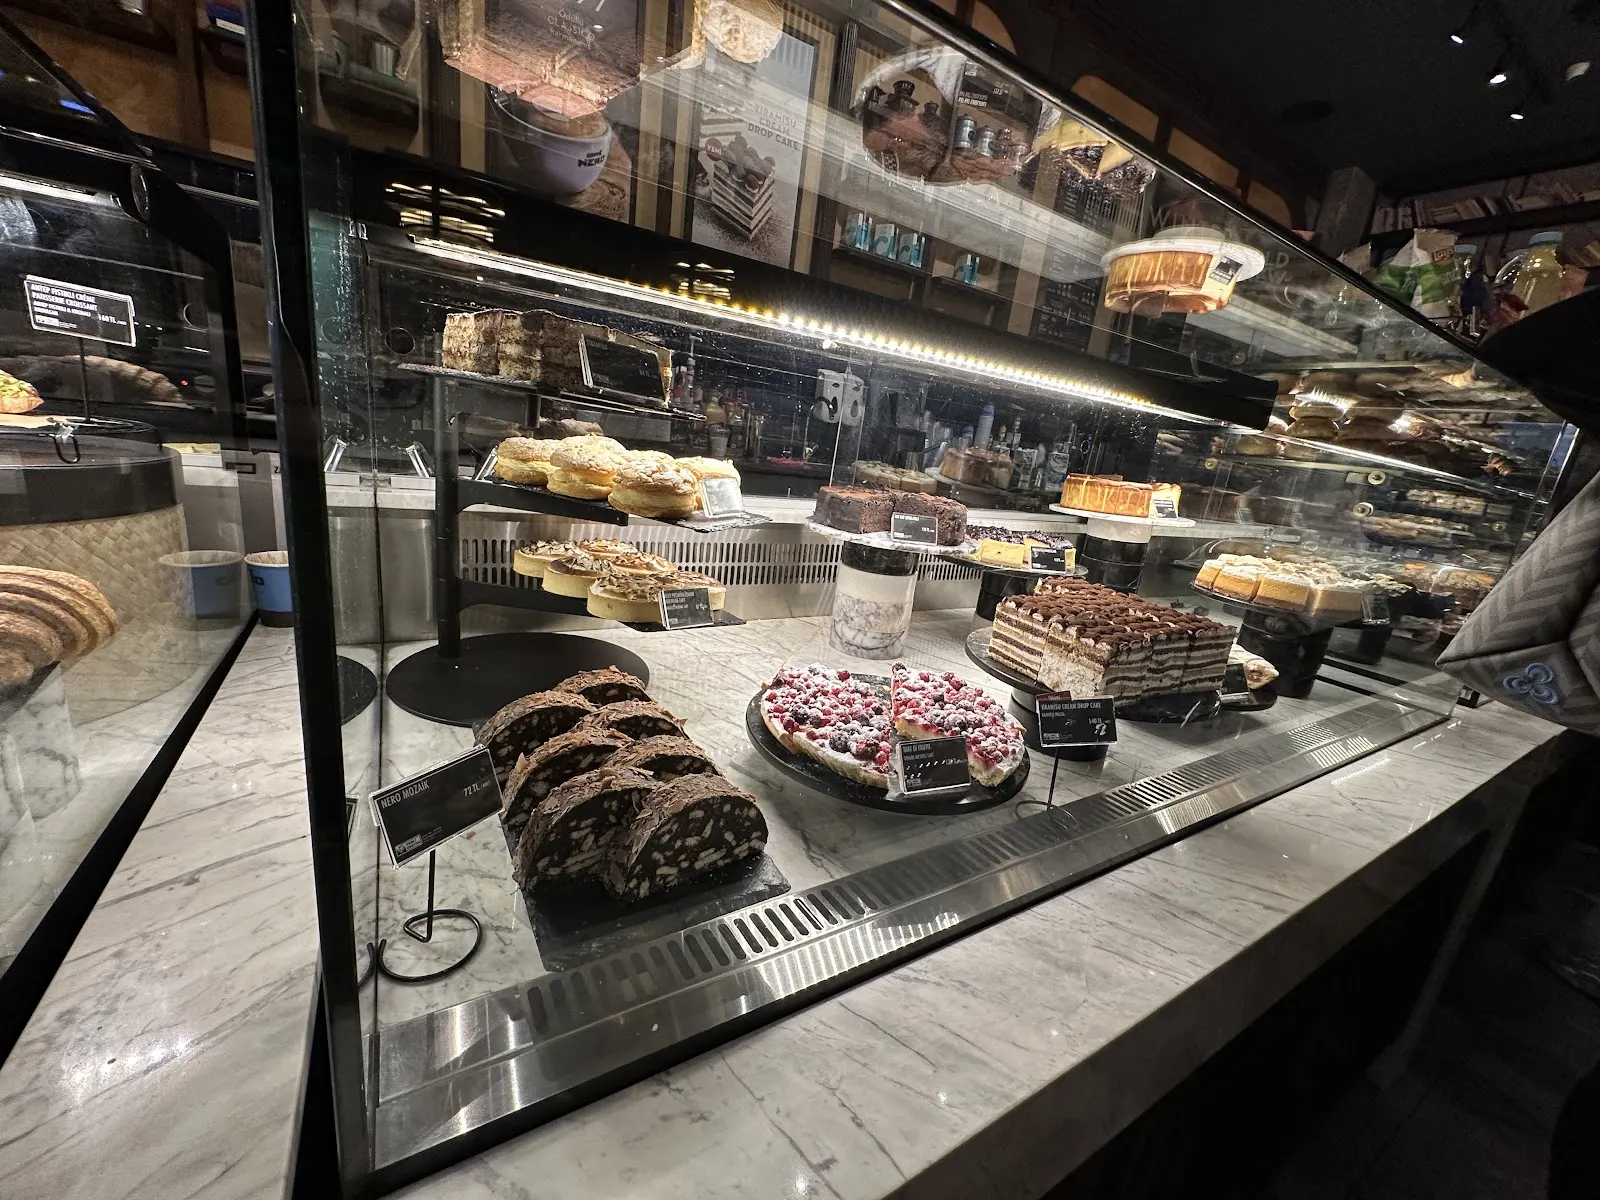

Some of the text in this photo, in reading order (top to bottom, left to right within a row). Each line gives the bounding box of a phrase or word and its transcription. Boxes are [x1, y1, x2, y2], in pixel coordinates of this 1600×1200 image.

[759, 117, 790, 136] CREAM
[747, 123, 800, 150] DROP CAKE
[31, 283, 51, 293] ANTEP
[66, 299, 98, 312] CROISSANT
[381, 793, 402, 809] NERO
